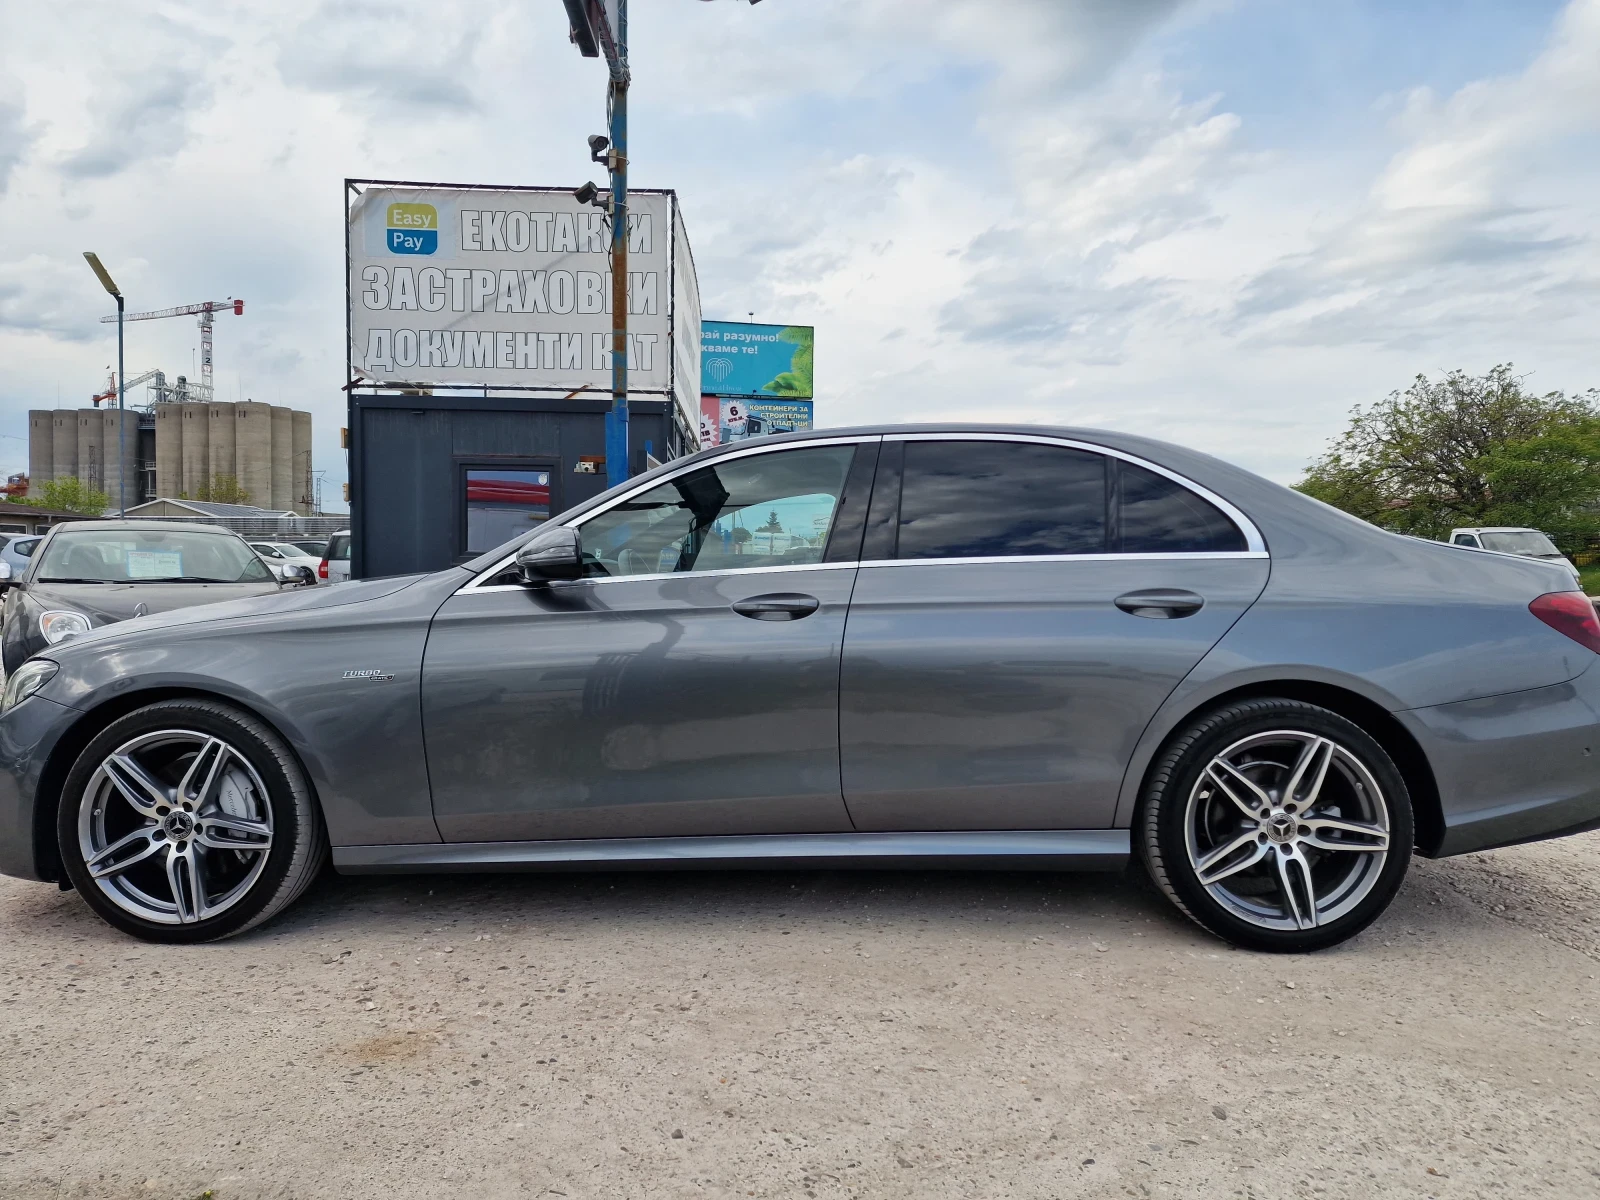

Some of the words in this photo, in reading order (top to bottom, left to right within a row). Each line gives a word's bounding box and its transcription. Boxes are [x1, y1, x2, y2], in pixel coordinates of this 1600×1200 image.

[393, 209, 432, 228] Easy
[393, 232, 423, 251] Pay
[723, 332, 779, 343] разумно!
[363, 328, 583, 372] ДОКУМЕНТИ
[742, 345, 758, 354] те!
[730, 406, 739, 416] 6
